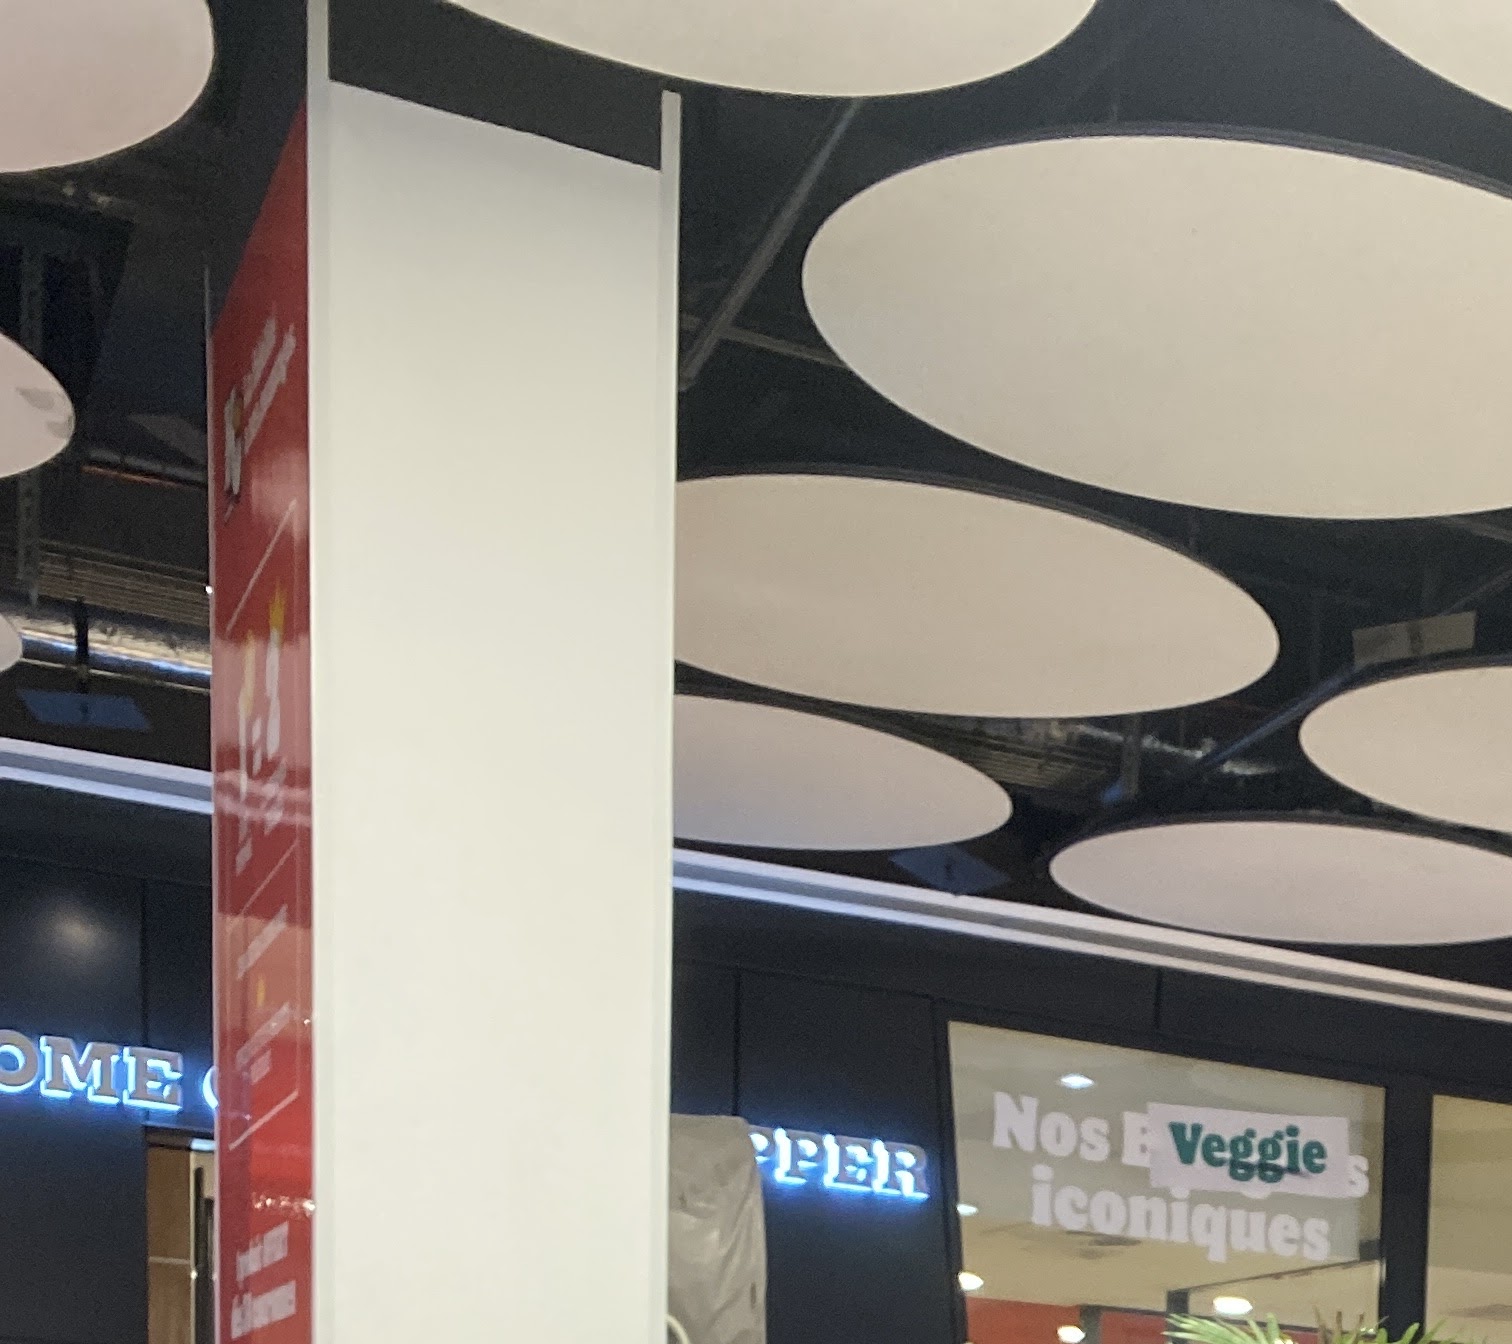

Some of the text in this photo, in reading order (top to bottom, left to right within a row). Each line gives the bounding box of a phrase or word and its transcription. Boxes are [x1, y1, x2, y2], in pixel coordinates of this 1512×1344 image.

[992, 1091, 1111, 1162] Nos
[1168, 1120, 1328, 1184] Veggie
[1031, 1163, 1331, 1264] iconiques
